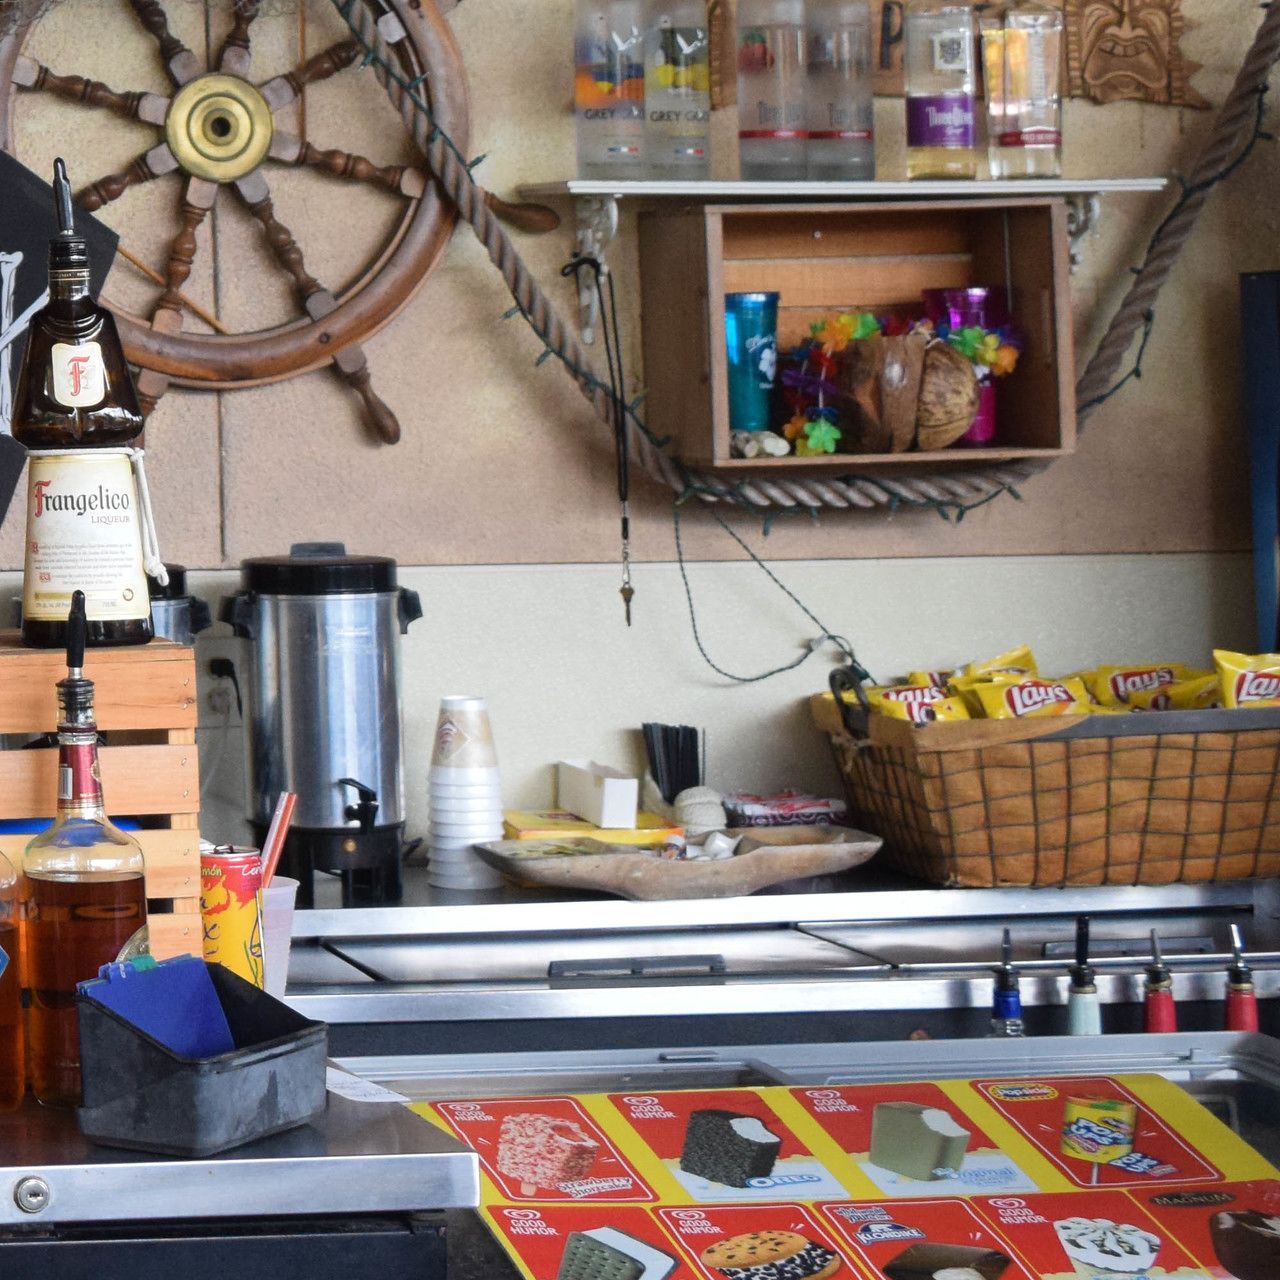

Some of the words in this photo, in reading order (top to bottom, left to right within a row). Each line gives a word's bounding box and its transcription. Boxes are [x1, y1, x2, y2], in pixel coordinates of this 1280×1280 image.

[584, 108, 615, 120] GREY
[649, 110, 681, 121] GREY
[34, 480, 130, 518] Frangelico
[91, 515, 130, 526] LIQUEUR
[814, 1098, 848, 1106] GOOD
[456, 1109, 486, 1117] GOOD
[631, 1104, 664, 1113] GOOD
[813, 1104, 859, 1113] HUMOR
[630, 1111, 676, 1119] HUMOR
[556, 1176, 633, 1192] Strawberry
[749, 1173, 819, 1188] OREO
[999, 1207, 1034, 1217] GOOD
[511, 1219, 547, 1228] GOOD
[677, 1219, 707, 1228] GOOD
[999, 1214, 1049, 1225] HUMOR
[509, 1226, 562, 1237] HUMOR
[676, 1226, 725, 1236] HUMOR
[855, 1228, 923, 1245] KLONDIKE
